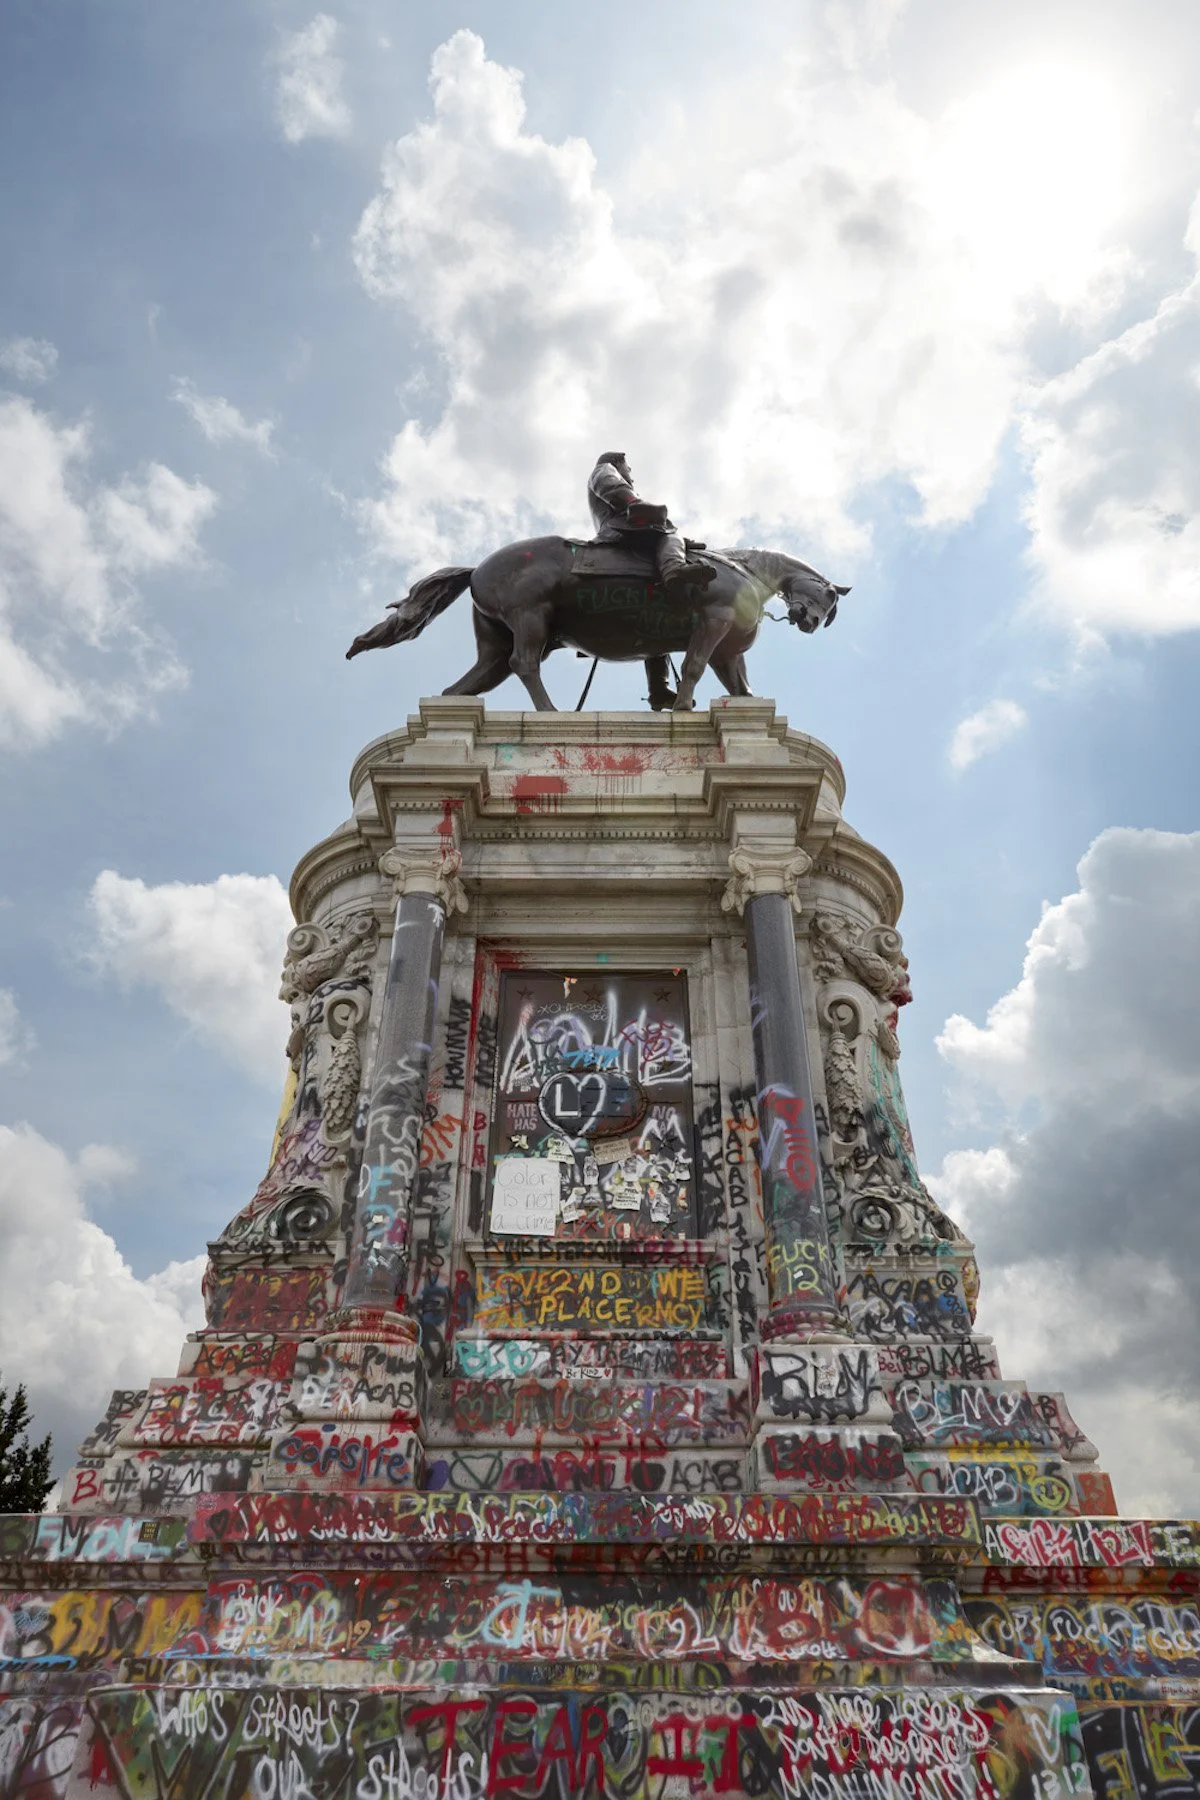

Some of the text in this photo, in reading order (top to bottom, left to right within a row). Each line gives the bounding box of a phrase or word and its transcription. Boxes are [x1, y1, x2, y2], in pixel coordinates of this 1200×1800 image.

[576, 585, 639, 612] FUCK
[506, 1103, 537, 1117] HATE
[513, 1118, 537, 1132] HAS
[498, 1163, 548, 1187] Color
[769, 1240, 829, 1271] FUCK
[787, 1263, 823, 1294] 12
[538, 1295, 634, 1325] PLACE
[352, 1379, 414, 1409] ACAB
[897, 1384, 1001, 1437] BLM
[670, 1459, 743, 1492] ACAB
[981, 1613, 1043, 1645] COPS
[1052, 1616, 1130, 1648] SUCK
[406, 1700, 609, 1800] TEAR
